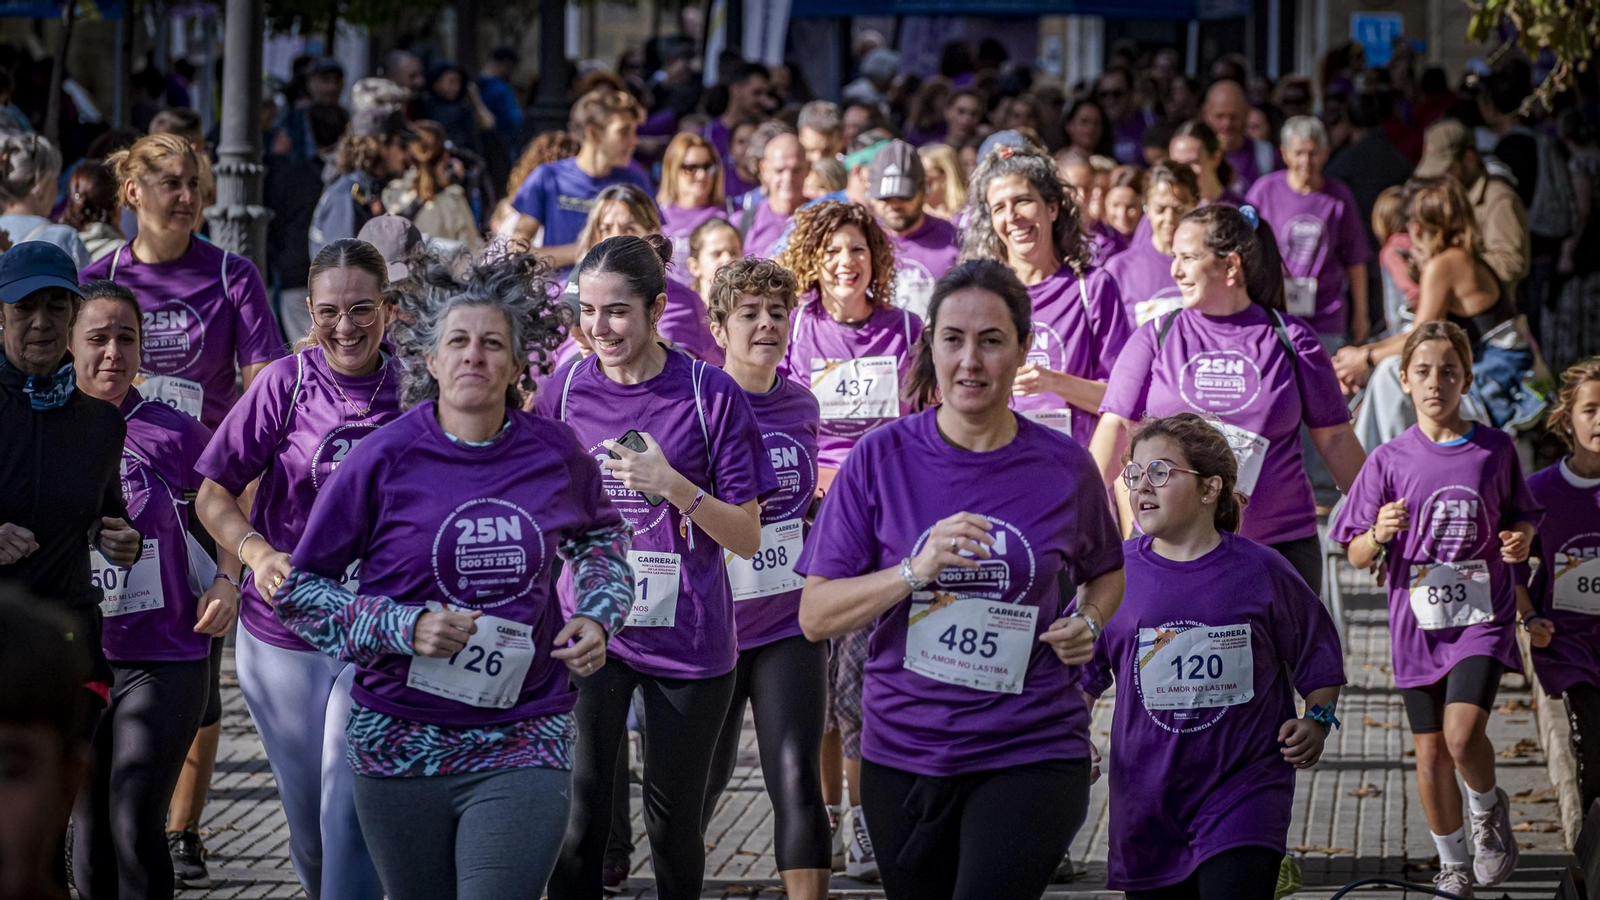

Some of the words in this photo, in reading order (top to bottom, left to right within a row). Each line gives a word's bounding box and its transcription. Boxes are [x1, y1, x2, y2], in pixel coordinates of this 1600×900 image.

[142, 310, 188, 330] 25N
[1196, 358, 1244, 374] 25N
[836, 379, 873, 396] 437
[770, 446, 798, 468] 5N
[456, 499, 478, 512] CONTRA
[487, 498, 517, 510] VIOLENCIA
[516, 506, 532, 522] HACIA
[1432, 500, 1478, 520] 25N
[454, 516, 522, 545] 25N
[776, 524, 800, 532] CARRERA
[460, 560, 481, 568] 900
[483, 559, 494, 567] 21
[496, 558, 506, 566] 21
[508, 557, 522, 565] 30
[638, 556, 676, 564] CARRERA
[752, 546, 788, 571] 898
[91, 568, 132, 590] 507
[940, 572, 962, 581] 900
[964, 572, 975, 580] 21
[990, 571, 1005, 580] 30
[128, 590, 150, 599] LUCHA
[482, 596, 517, 608] VIOLENCIA
[1428, 583, 1466, 604] 833
[988, 607, 1032, 618] CARRERA
[938, 624, 998, 658] 485
[1208, 630, 1247, 638] CARRERA
[921, 650, 930, 659] EL
[932, 653, 956, 666] AMOR
[958, 660, 970, 669] NO
[972, 663, 1008, 674] LASTIMA
[1171, 654, 1222, 680] 120
[1206, 683, 1237, 692] LASTIMA
[1152, 716, 1170, 732] CONTRA
[1181, 723, 1212, 733] VIOLENCIA
